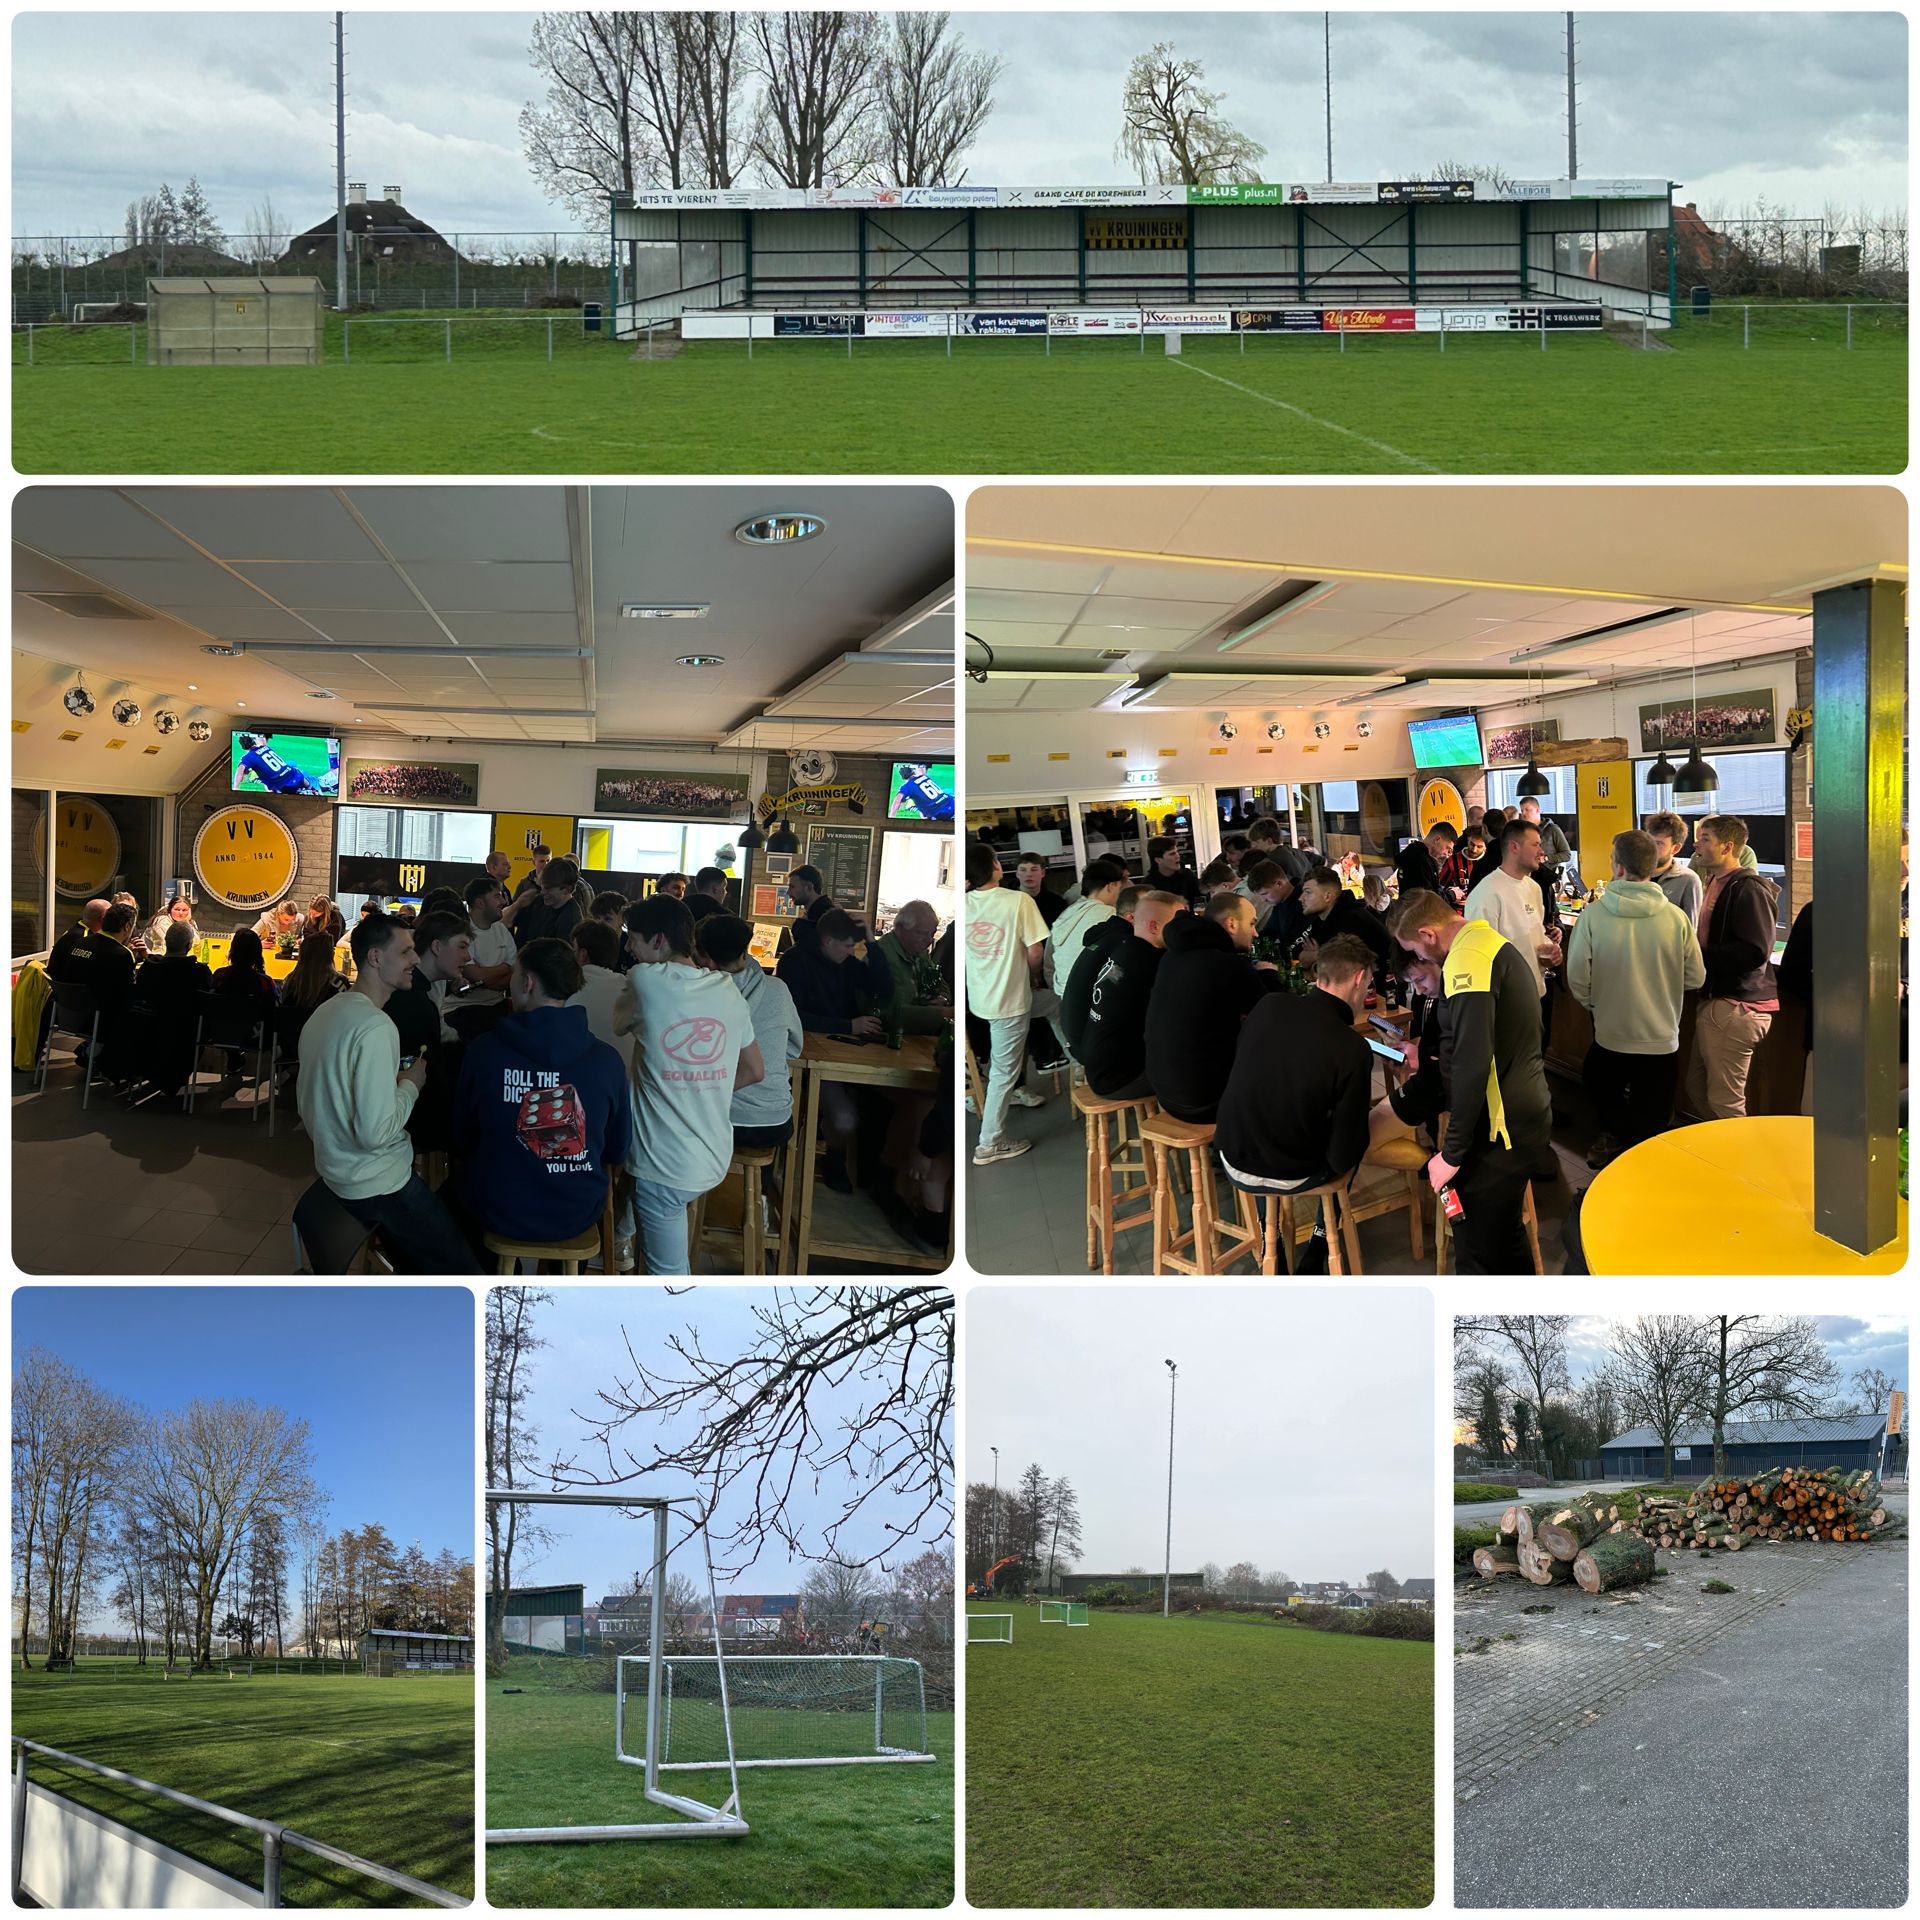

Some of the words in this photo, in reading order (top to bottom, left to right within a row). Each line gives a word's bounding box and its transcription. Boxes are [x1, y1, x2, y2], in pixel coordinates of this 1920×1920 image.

[640, 195, 659, 204] IETS
[661, 195, 673, 204] TE
[677, 195, 718, 204] VIEREN?
[1202, 187, 1239, 197] PLUS
[1244, 188, 1277, 200] plus.nl
[1107, 221, 1184, 237] KRUININGEN
[874, 314, 929, 323] INTERSPORT
[979, 318, 997, 326] van
[998, 317, 1047, 328] kruiningen
[215, 853, 236, 863] ANNO
[253, 851, 274, 861] 1944
[225, 889, 271, 904] KRUININGEN
[71, 947, 93, 959] LEIDER
[503, 1068, 533, 1087] ROLL
[536, 1071, 560, 1088] THE
[545, 1163, 567, 1174] YOU
[569, 1161, 593, 1173] LOVE
